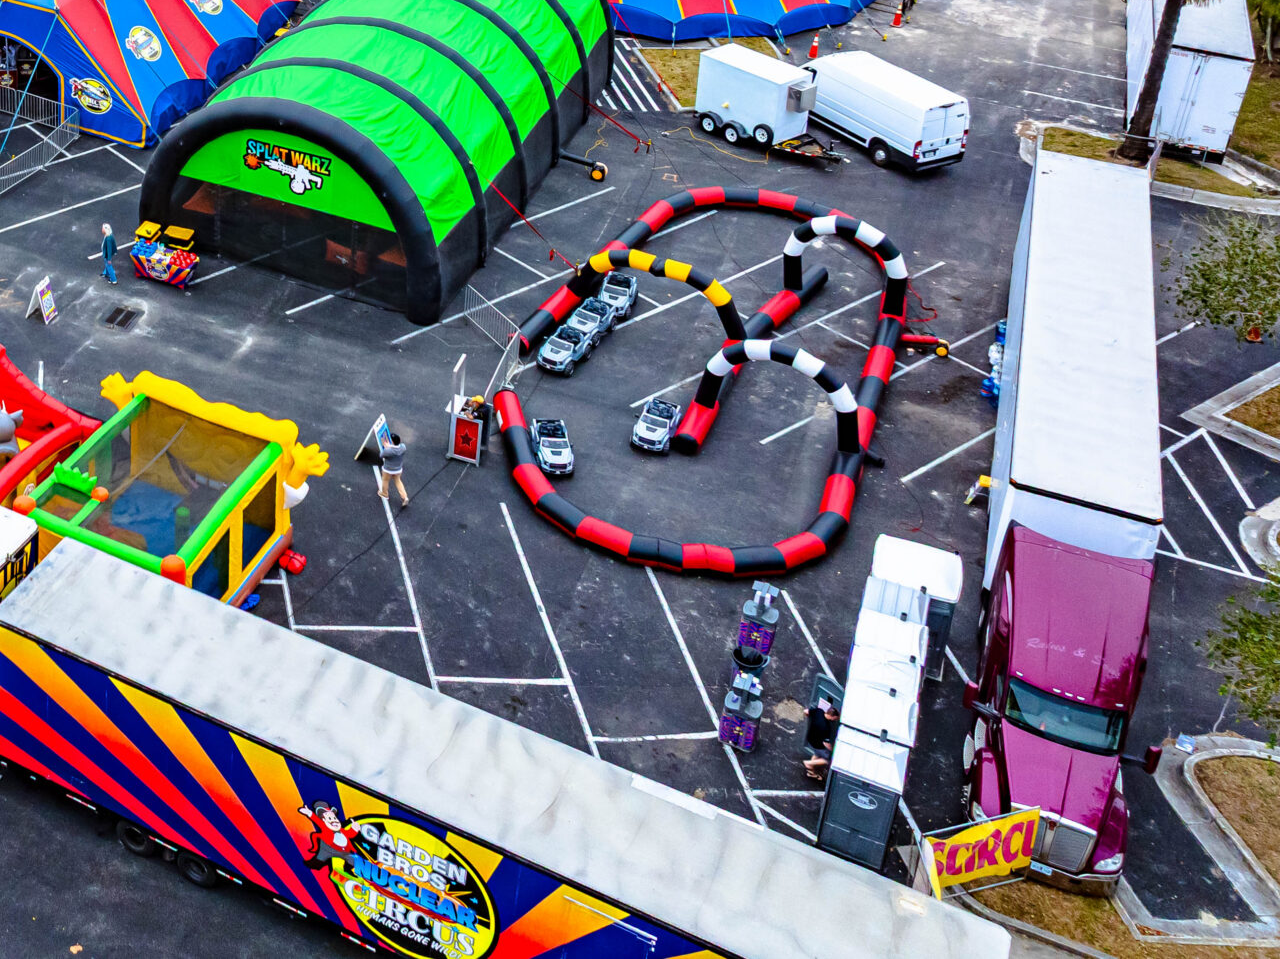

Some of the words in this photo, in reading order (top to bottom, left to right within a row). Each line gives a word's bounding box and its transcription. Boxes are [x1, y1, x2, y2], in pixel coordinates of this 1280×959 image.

[247, 140, 289, 163] SPLAT
[290, 150, 331, 175] WARZ
[360, 823, 468, 886] GARDEN
[376, 846, 448, 893] BROS
[344, 879, 476, 957] CIRCUS
[352, 854, 480, 934] NUCLEAR
[355, 903, 401, 930] HUMANS
[400, 925, 430, 947] GONE
[430, 940, 463, 959] WILD!
